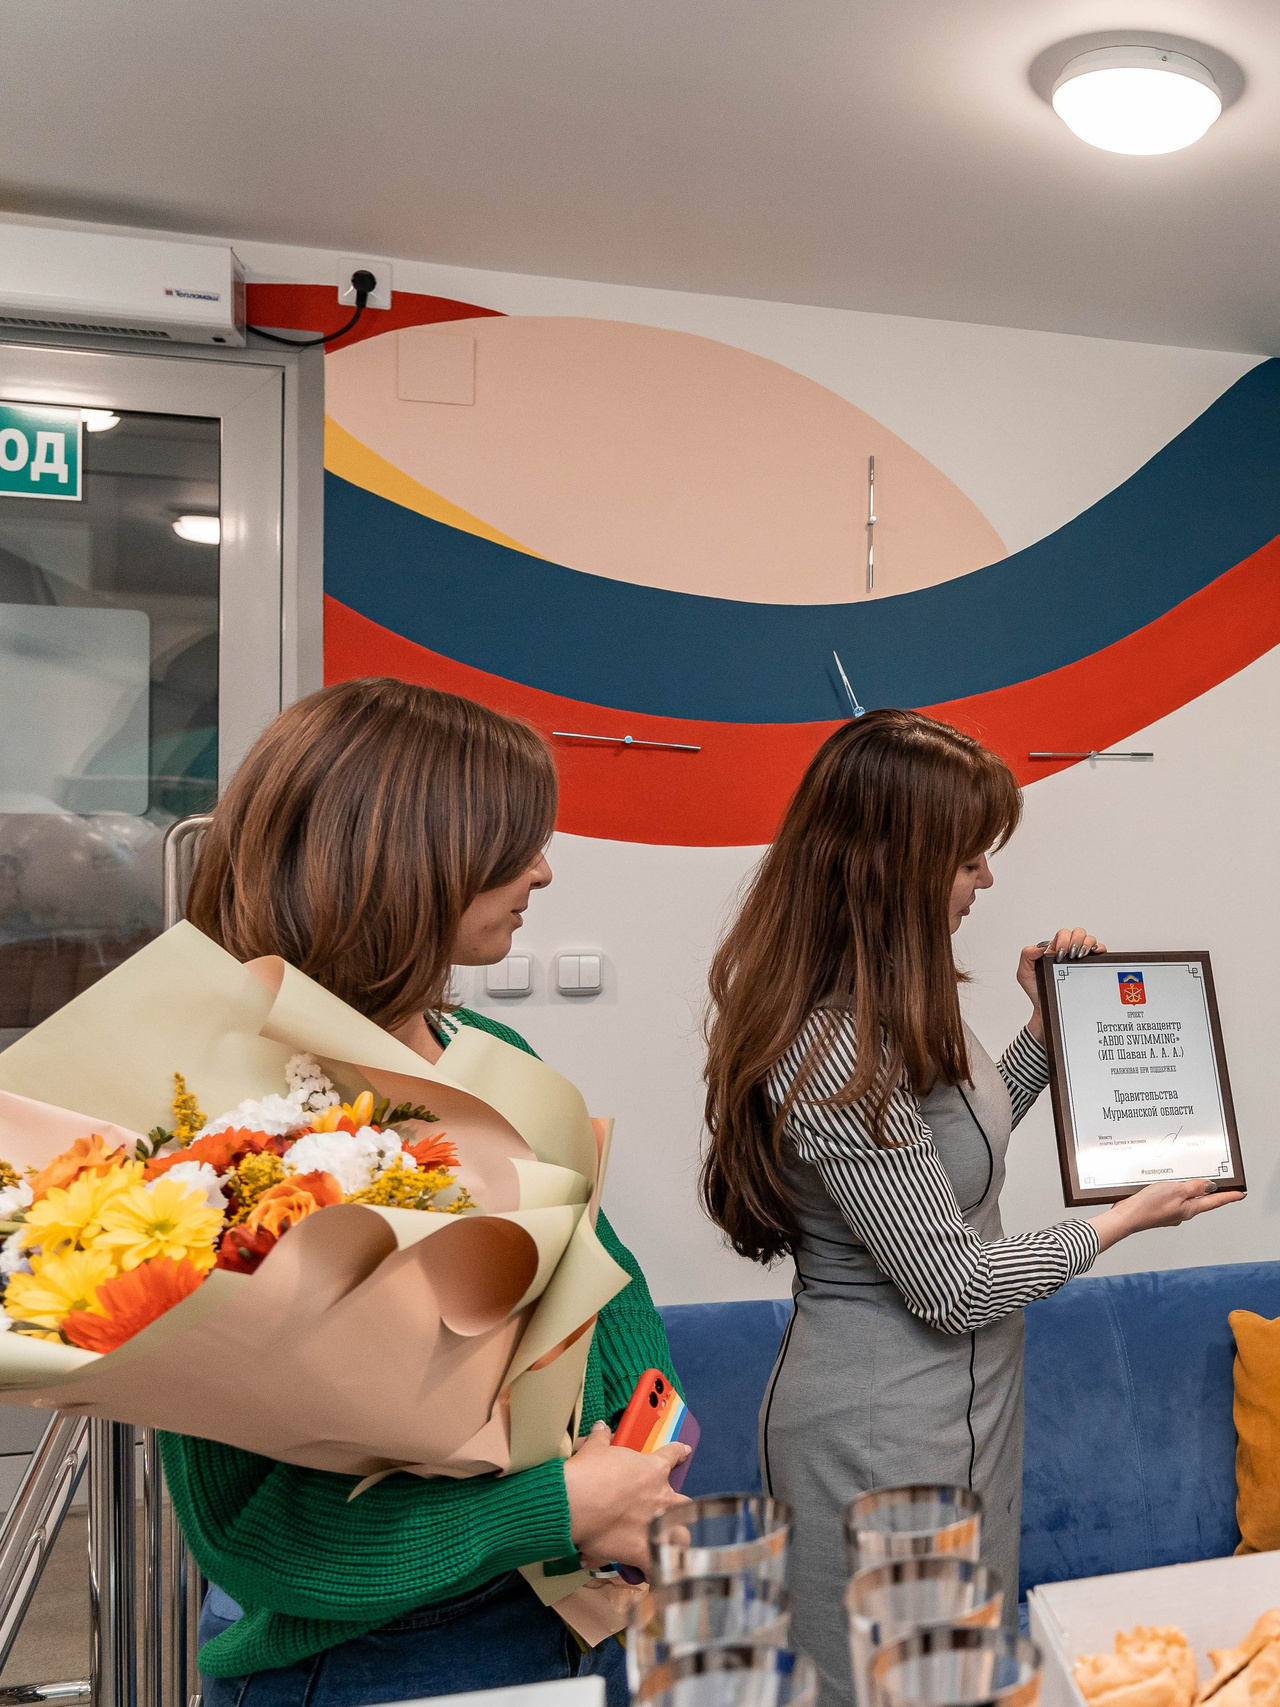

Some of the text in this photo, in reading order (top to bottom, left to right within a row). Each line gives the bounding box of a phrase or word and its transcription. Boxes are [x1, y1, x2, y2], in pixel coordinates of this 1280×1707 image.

[1097, 1021, 1182, 1033] Детский аквацентр
[1098, 1034, 1180, 1046] «ABDO SWIMMING»
[1098, 1050, 1114, 1061] (ИП
[1117, 1049, 1147, 1060] Шабан
[1114, 1090, 1178, 1104] Правительства
[1102, 1105, 1194, 1122] Мурманской области
